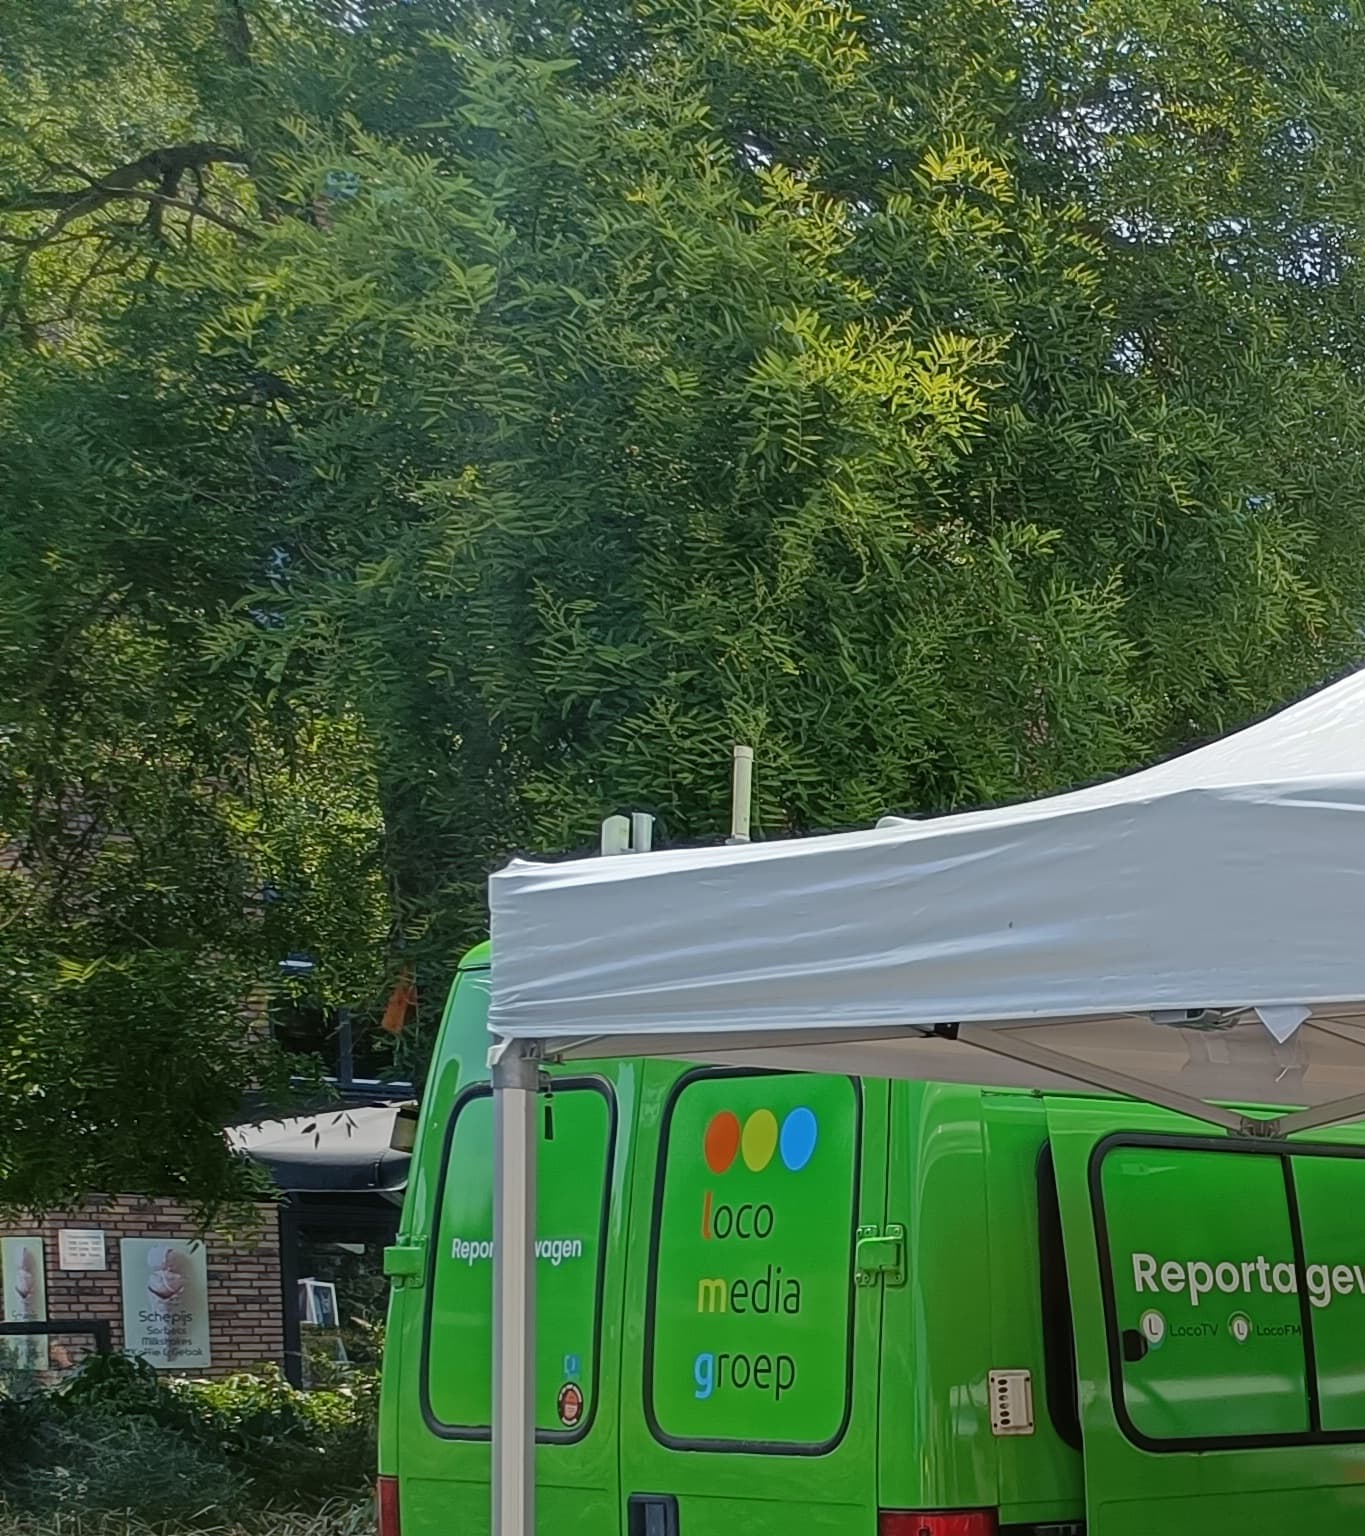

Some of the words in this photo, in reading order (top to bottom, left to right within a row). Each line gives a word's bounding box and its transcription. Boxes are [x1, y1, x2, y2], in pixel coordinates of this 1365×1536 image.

[702, 1190, 774, 1239] loco
[451, 1237, 582, 1266] Reporwagen
[698, 1264, 801, 1314] media
[138, 1310, 193, 1326] Schepijs
[1169, 1323, 1219, 1337] LocoTV
[694, 1352, 796, 1401] groep
